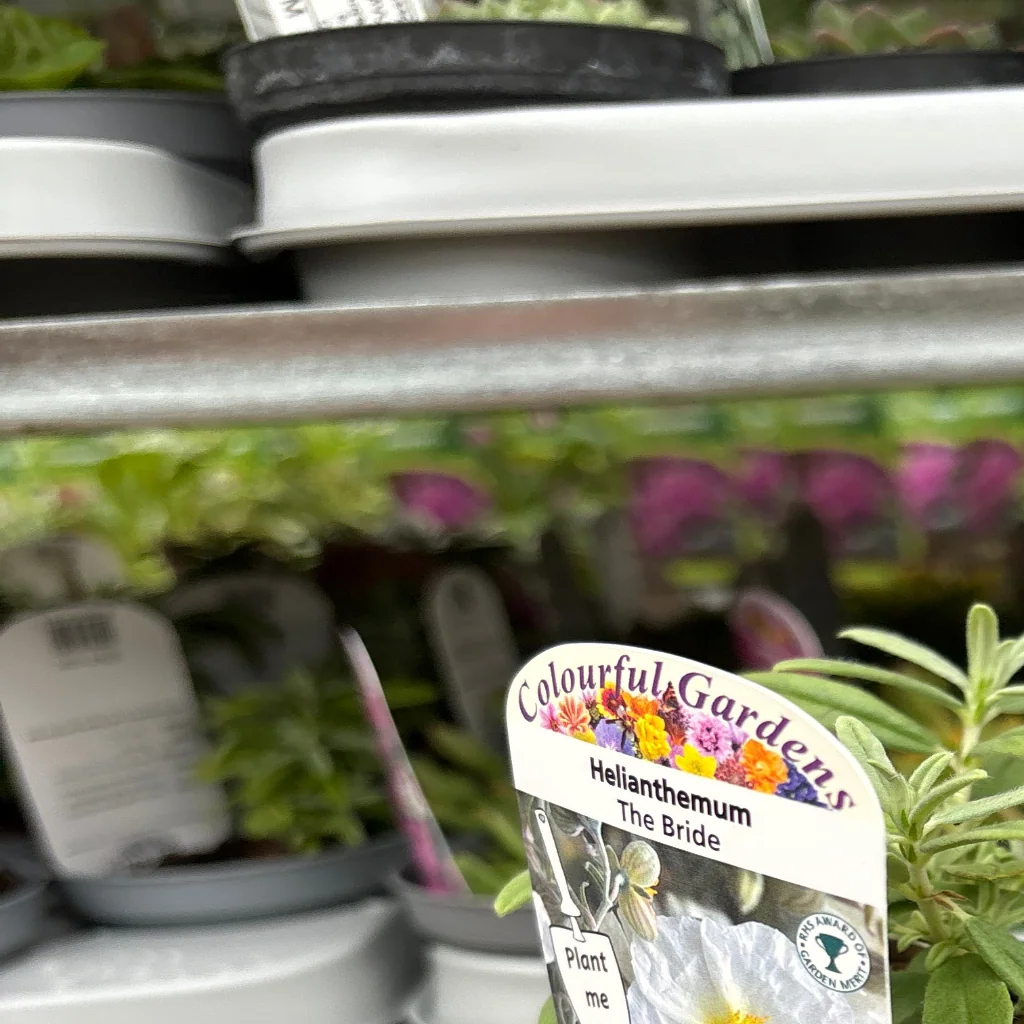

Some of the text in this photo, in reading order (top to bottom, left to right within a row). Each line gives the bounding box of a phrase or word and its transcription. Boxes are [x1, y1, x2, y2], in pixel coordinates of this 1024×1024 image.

[518, 654, 856, 811] Colourful Gardens
[590, 757, 752, 827] Helianthemum
[617, 799, 721, 852] The Bride
[799, 916, 867, 958] RHS AWARD OF
[565, 946, 608, 973] Plant
[800, 950, 867, 990] GARDEN MERIT
[585, 990, 610, 1010] me
